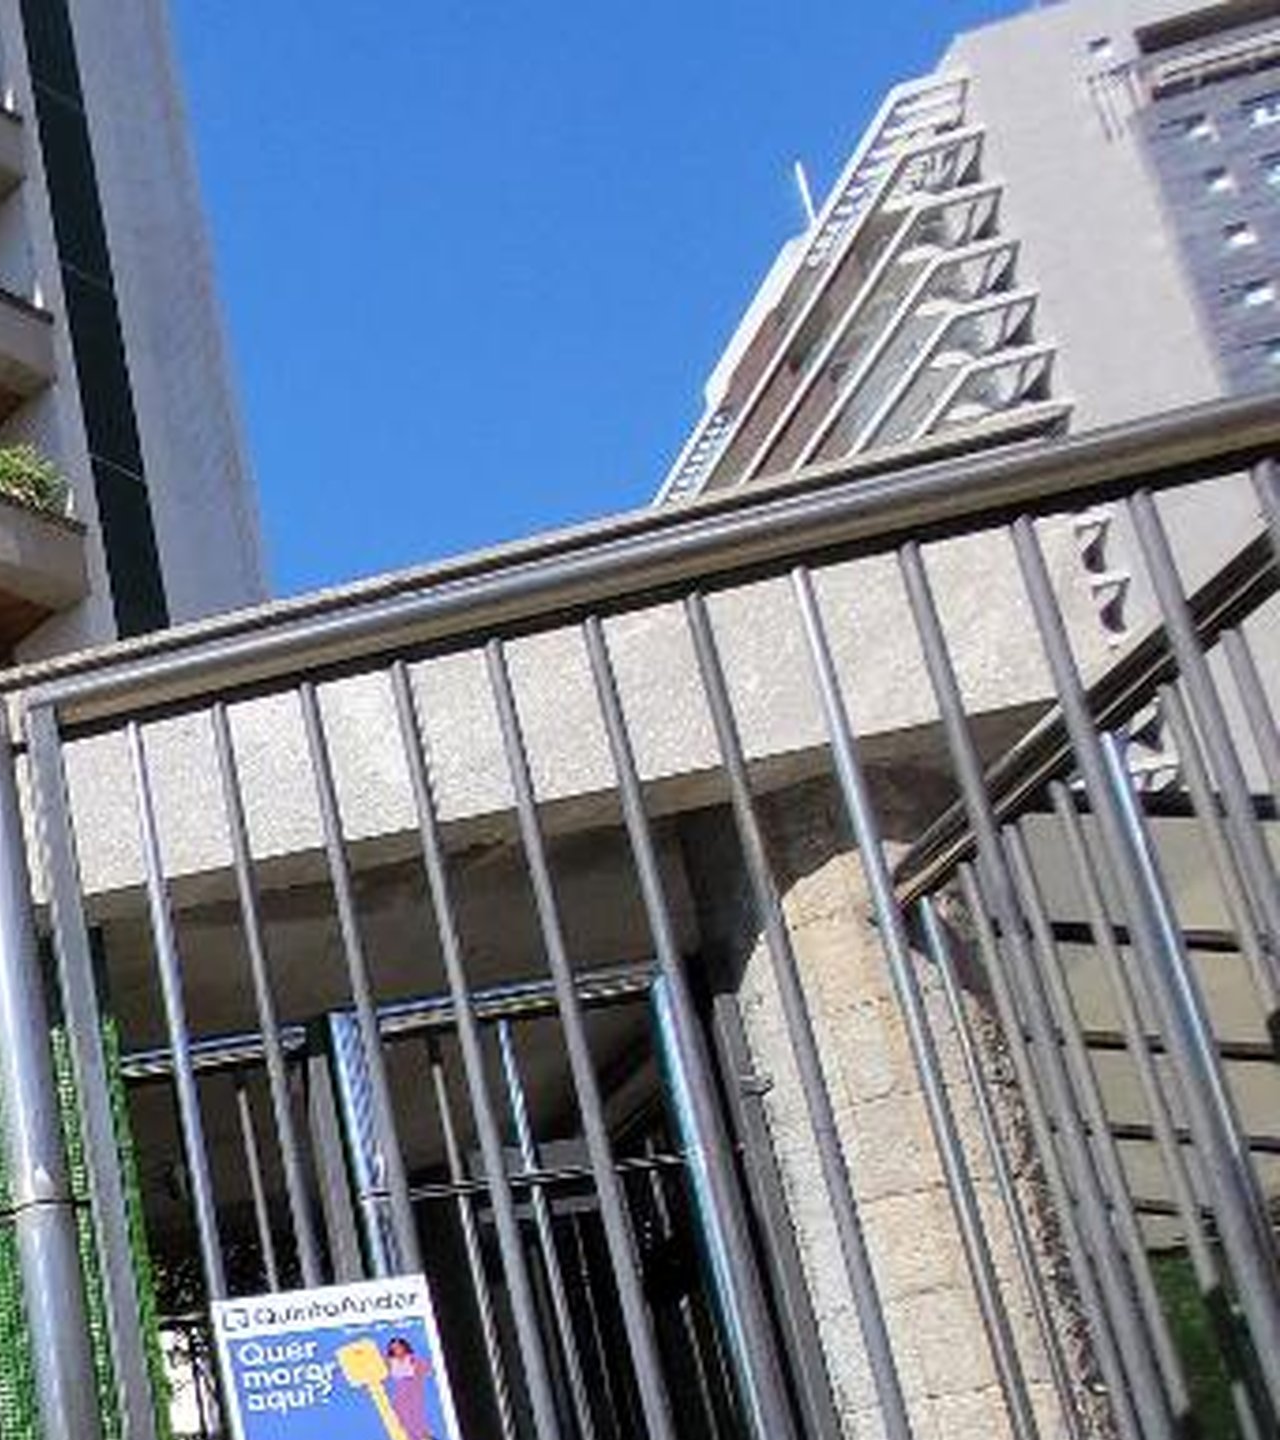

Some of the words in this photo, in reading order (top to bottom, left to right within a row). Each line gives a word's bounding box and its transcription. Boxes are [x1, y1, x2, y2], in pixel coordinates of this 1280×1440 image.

[238, 1339, 318, 1366] Quer
[242, 1360, 336, 1388] morar
[247, 1383, 333, 1415] aqui?
